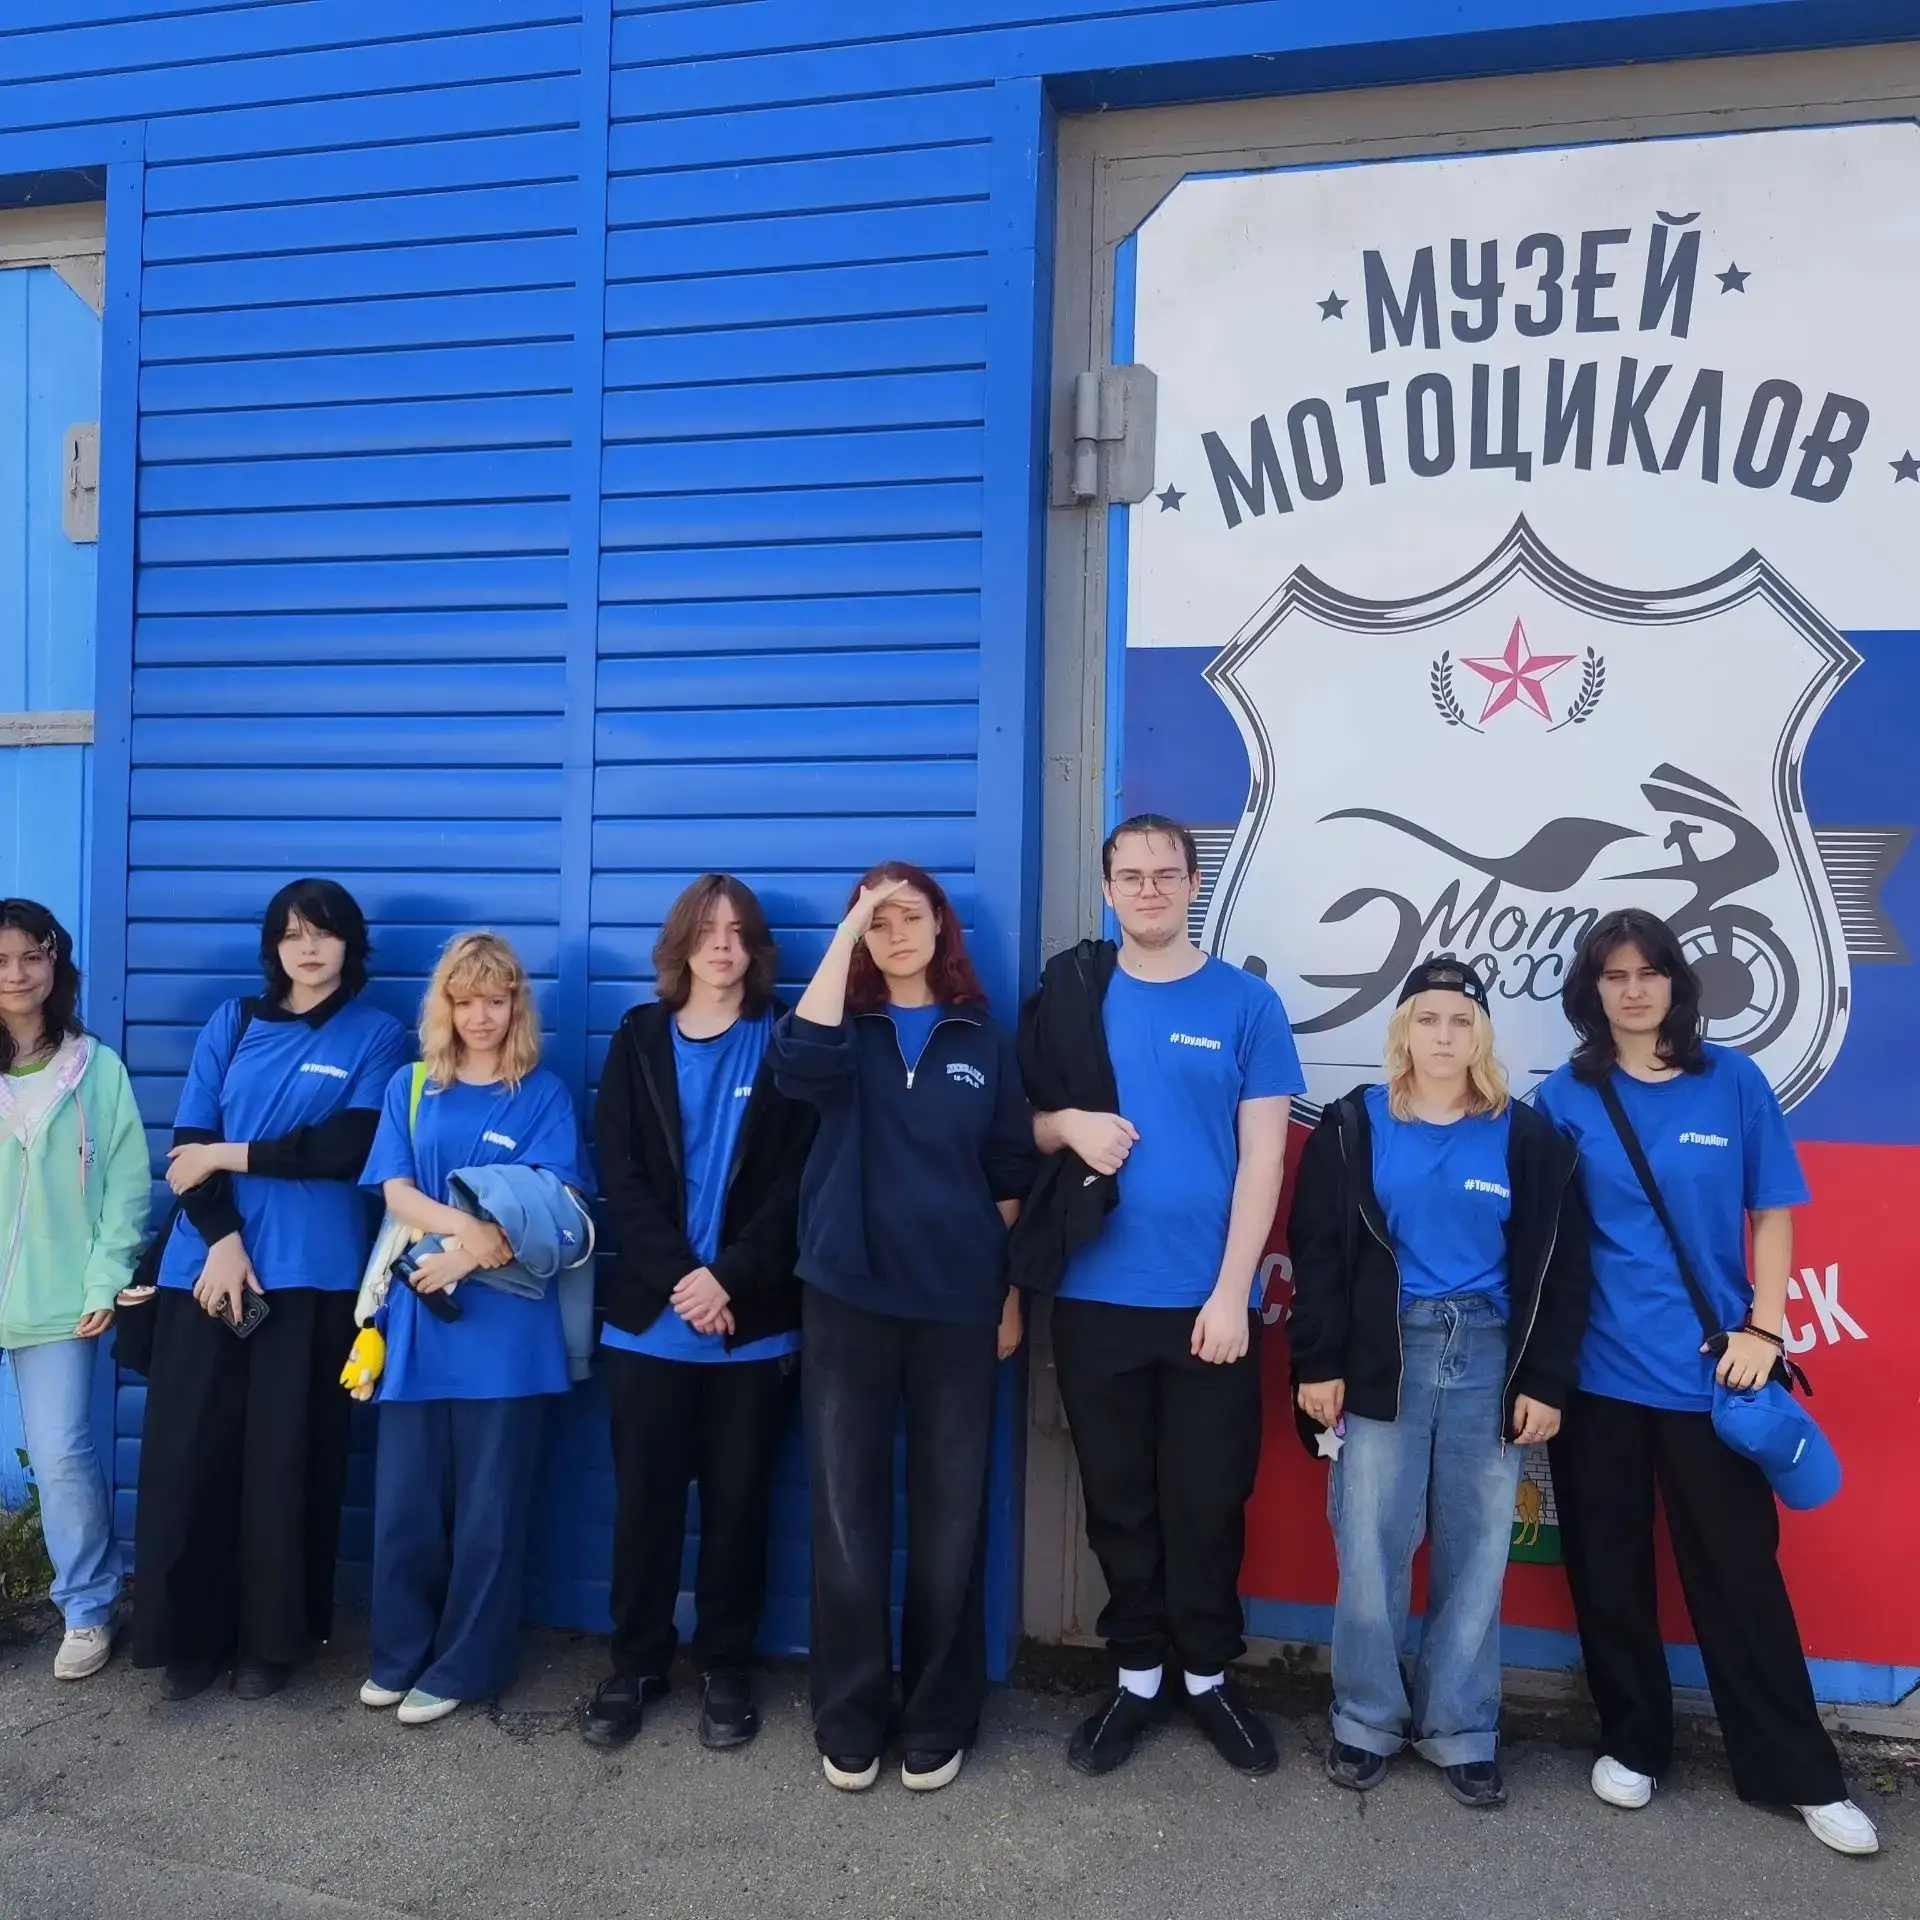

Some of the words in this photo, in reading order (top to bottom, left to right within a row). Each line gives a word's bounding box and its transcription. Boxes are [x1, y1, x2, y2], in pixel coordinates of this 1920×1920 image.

[1363, 210, 1702, 354] МУЗЕЙ
[1200, 355, 1871, 530] МОТОЦИКЛОВ
[1420, 877, 1599, 952] Мот
[1170, 1032, 1221, 1050] #ТрудКрут
[1679, 1131, 1729, 1147] #ТрудКрут
